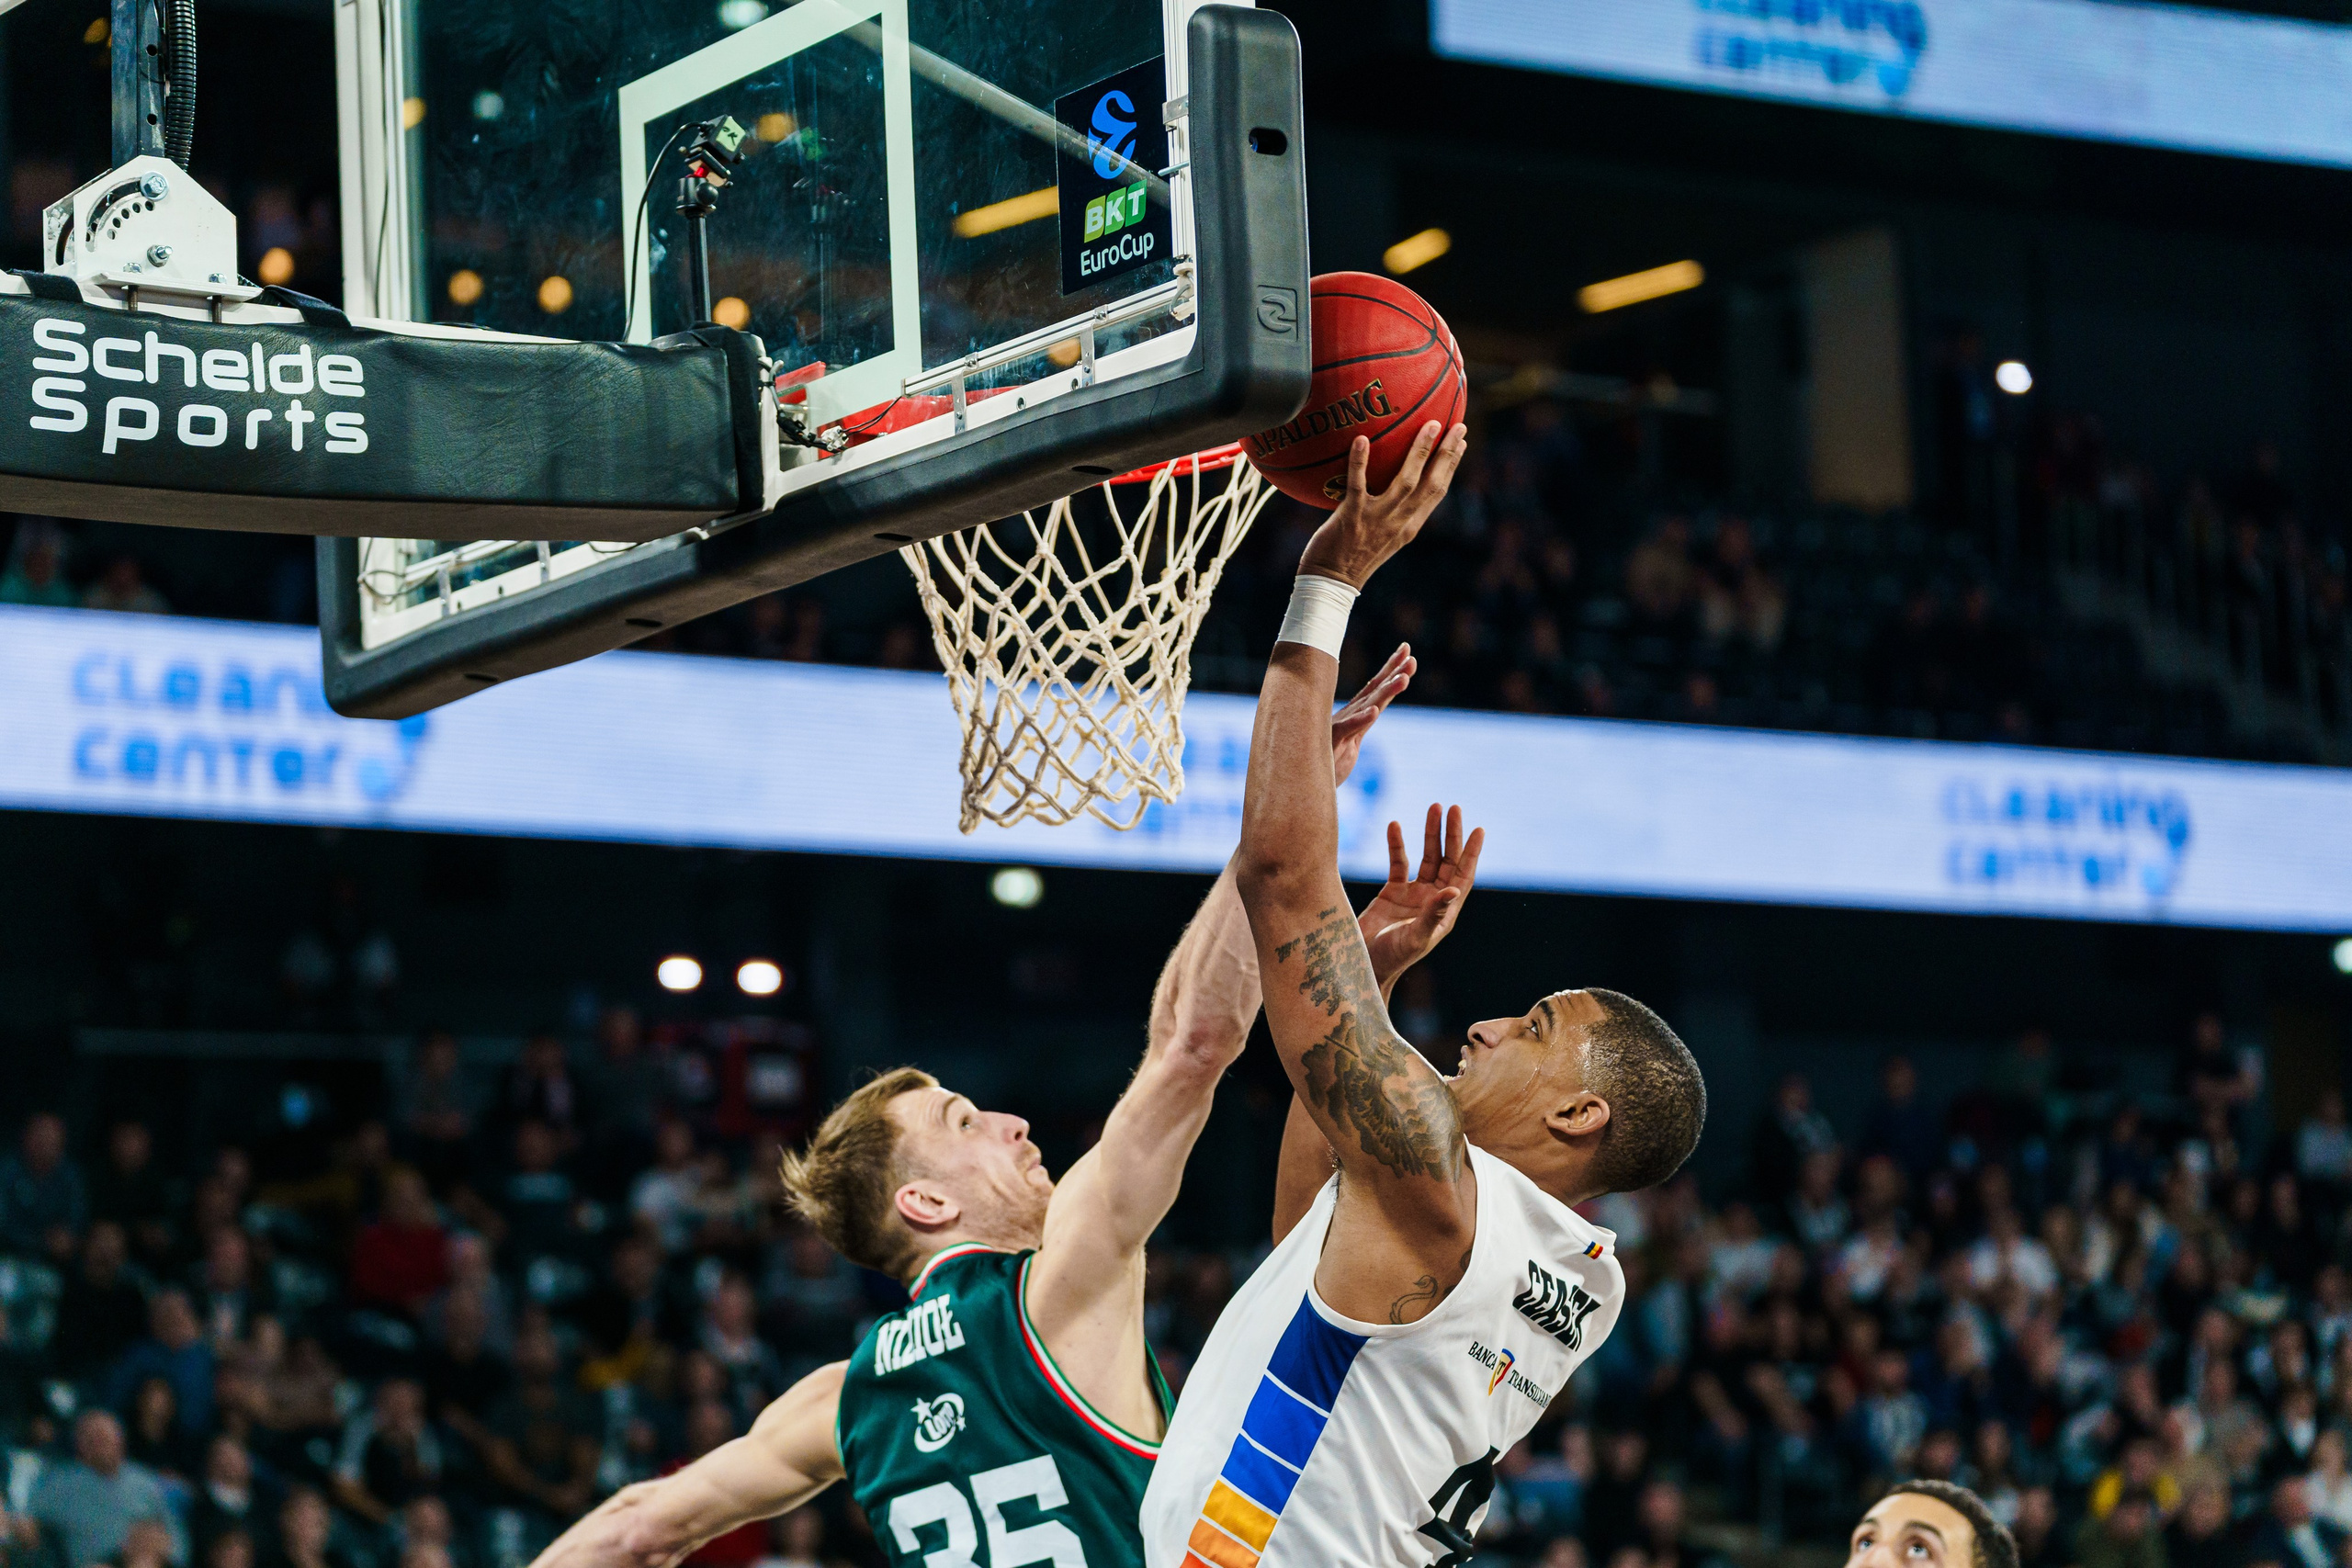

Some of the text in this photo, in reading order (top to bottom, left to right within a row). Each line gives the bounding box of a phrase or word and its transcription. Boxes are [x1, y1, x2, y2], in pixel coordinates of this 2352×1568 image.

[1086, 187, 1145, 235] BKT
[1080, 231, 1155, 276] EuroCup
[31, 318, 367, 398] Schelde
[29, 376, 369, 455] Sports
[1467, 1340, 1498, 1371] BANCA
[888, 1453, 1089, 1568] 35
